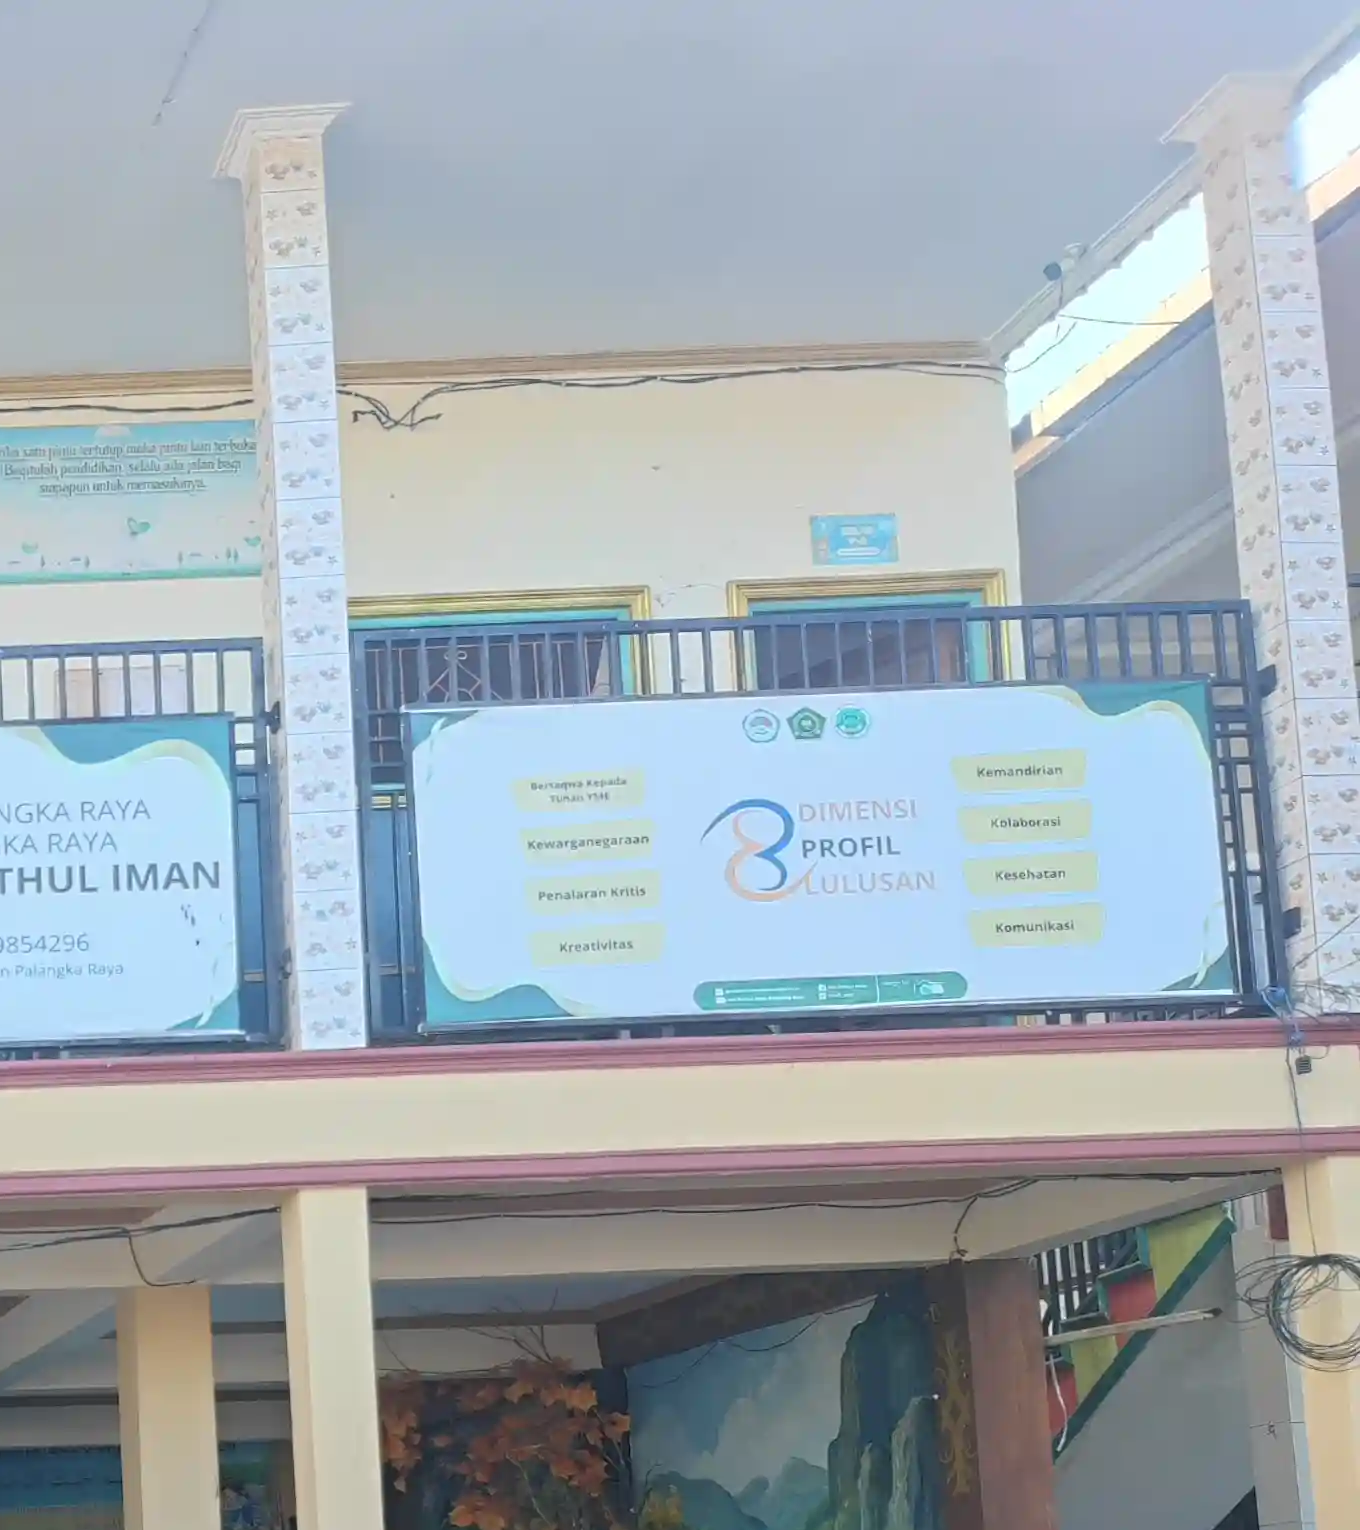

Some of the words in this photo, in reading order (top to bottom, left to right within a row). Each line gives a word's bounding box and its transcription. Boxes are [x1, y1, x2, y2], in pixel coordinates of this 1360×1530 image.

[976, 764, 1064, 779] Kemandirian
[80, 799, 152, 821] RAYA
[798, 798, 918, 823] DIMENSI
[990, 816, 1061, 830] Kolaborasi
[47, 831, 118, 854] RAYA
[527, 834, 650, 852] Kewarganegaraan
[801, 836, 901, 859] PROFIL
[112, 860, 221, 892] IMAN
[804, 870, 936, 896] LULUSAN
[995, 867, 1067, 882] Kesehatan
[537, 888, 607, 902] Penalaran
[610, 883, 647, 898] Kritis
[995, 920, 1075, 935] Komunikasi
[559, 938, 634, 954] Kreativitas
[15, 962, 83, 982] Palangka
[88, 962, 125, 979] Raya
